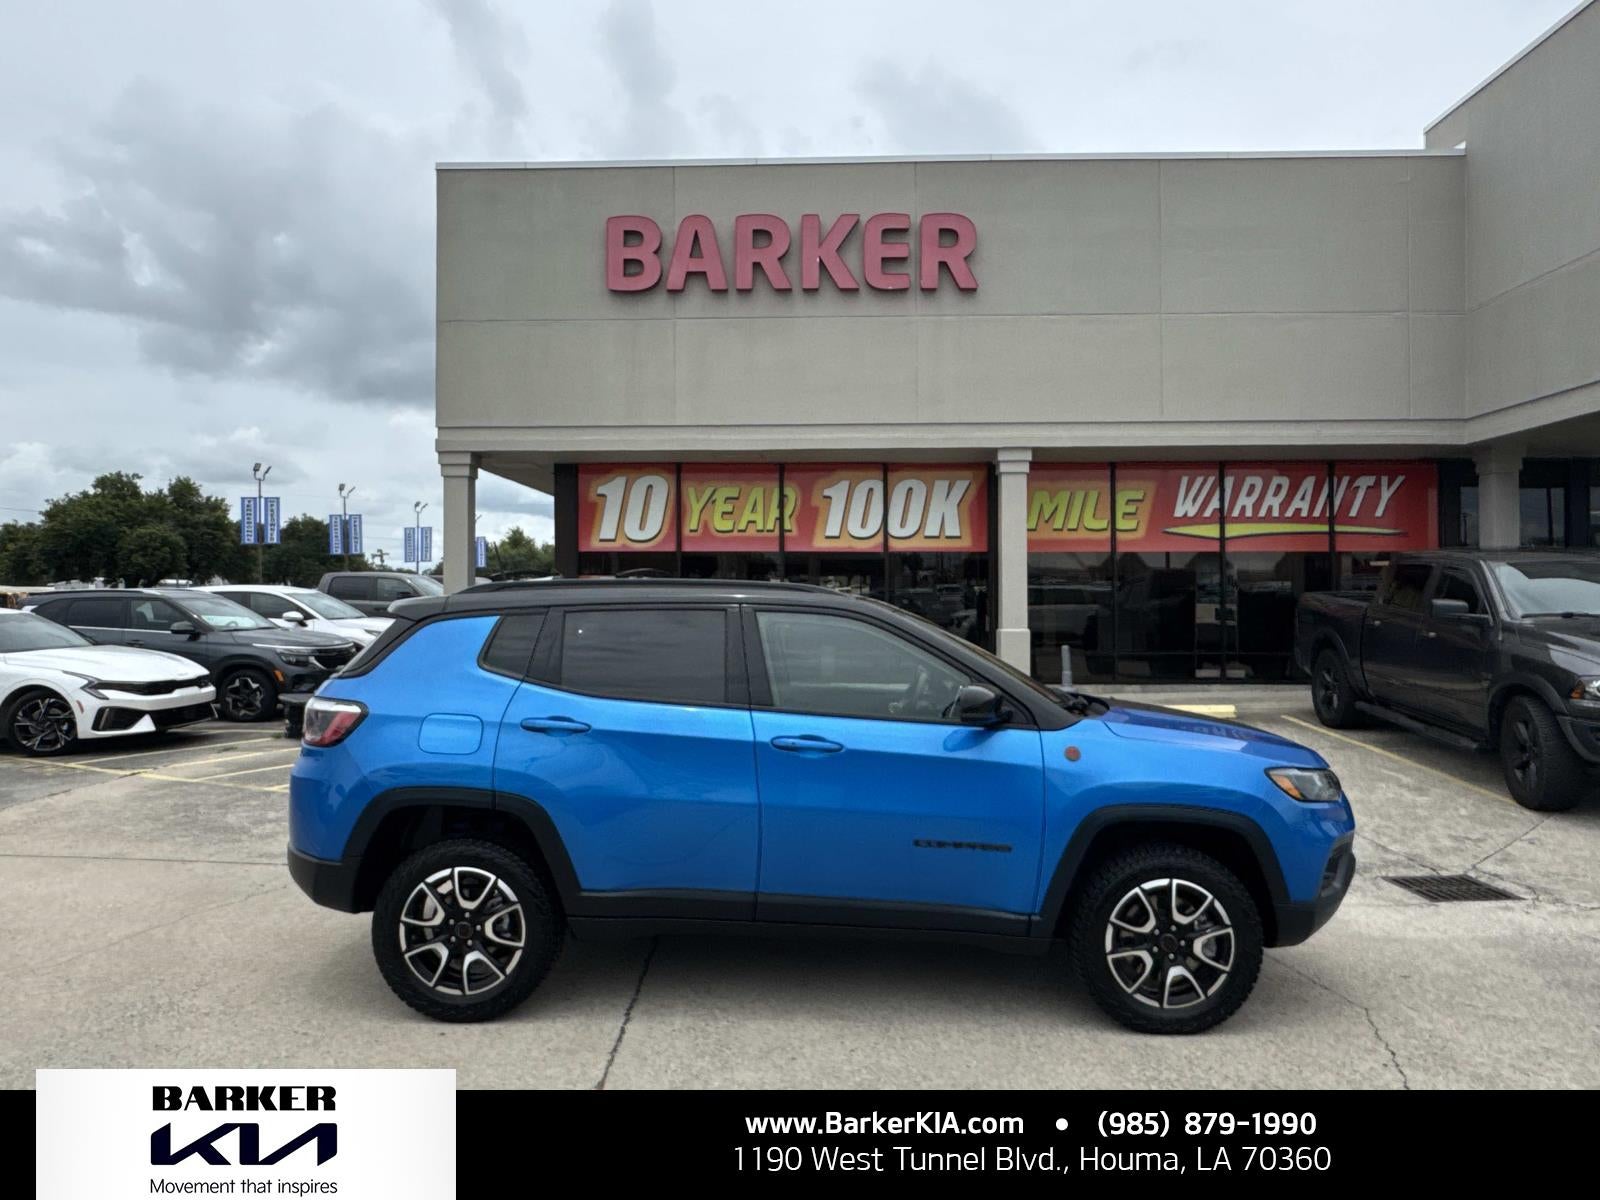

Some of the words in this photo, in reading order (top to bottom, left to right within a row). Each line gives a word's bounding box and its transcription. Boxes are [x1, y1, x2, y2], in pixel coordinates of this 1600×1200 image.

[605, 212, 978, 293] BARKER
[596, 474, 670, 543] 10
[686, 486, 797, 534] YEAR
[822, 478, 973, 541] 100K
[1027, 488, 1145, 533] MILE
[1172, 474, 1406, 518] WARRANTY
